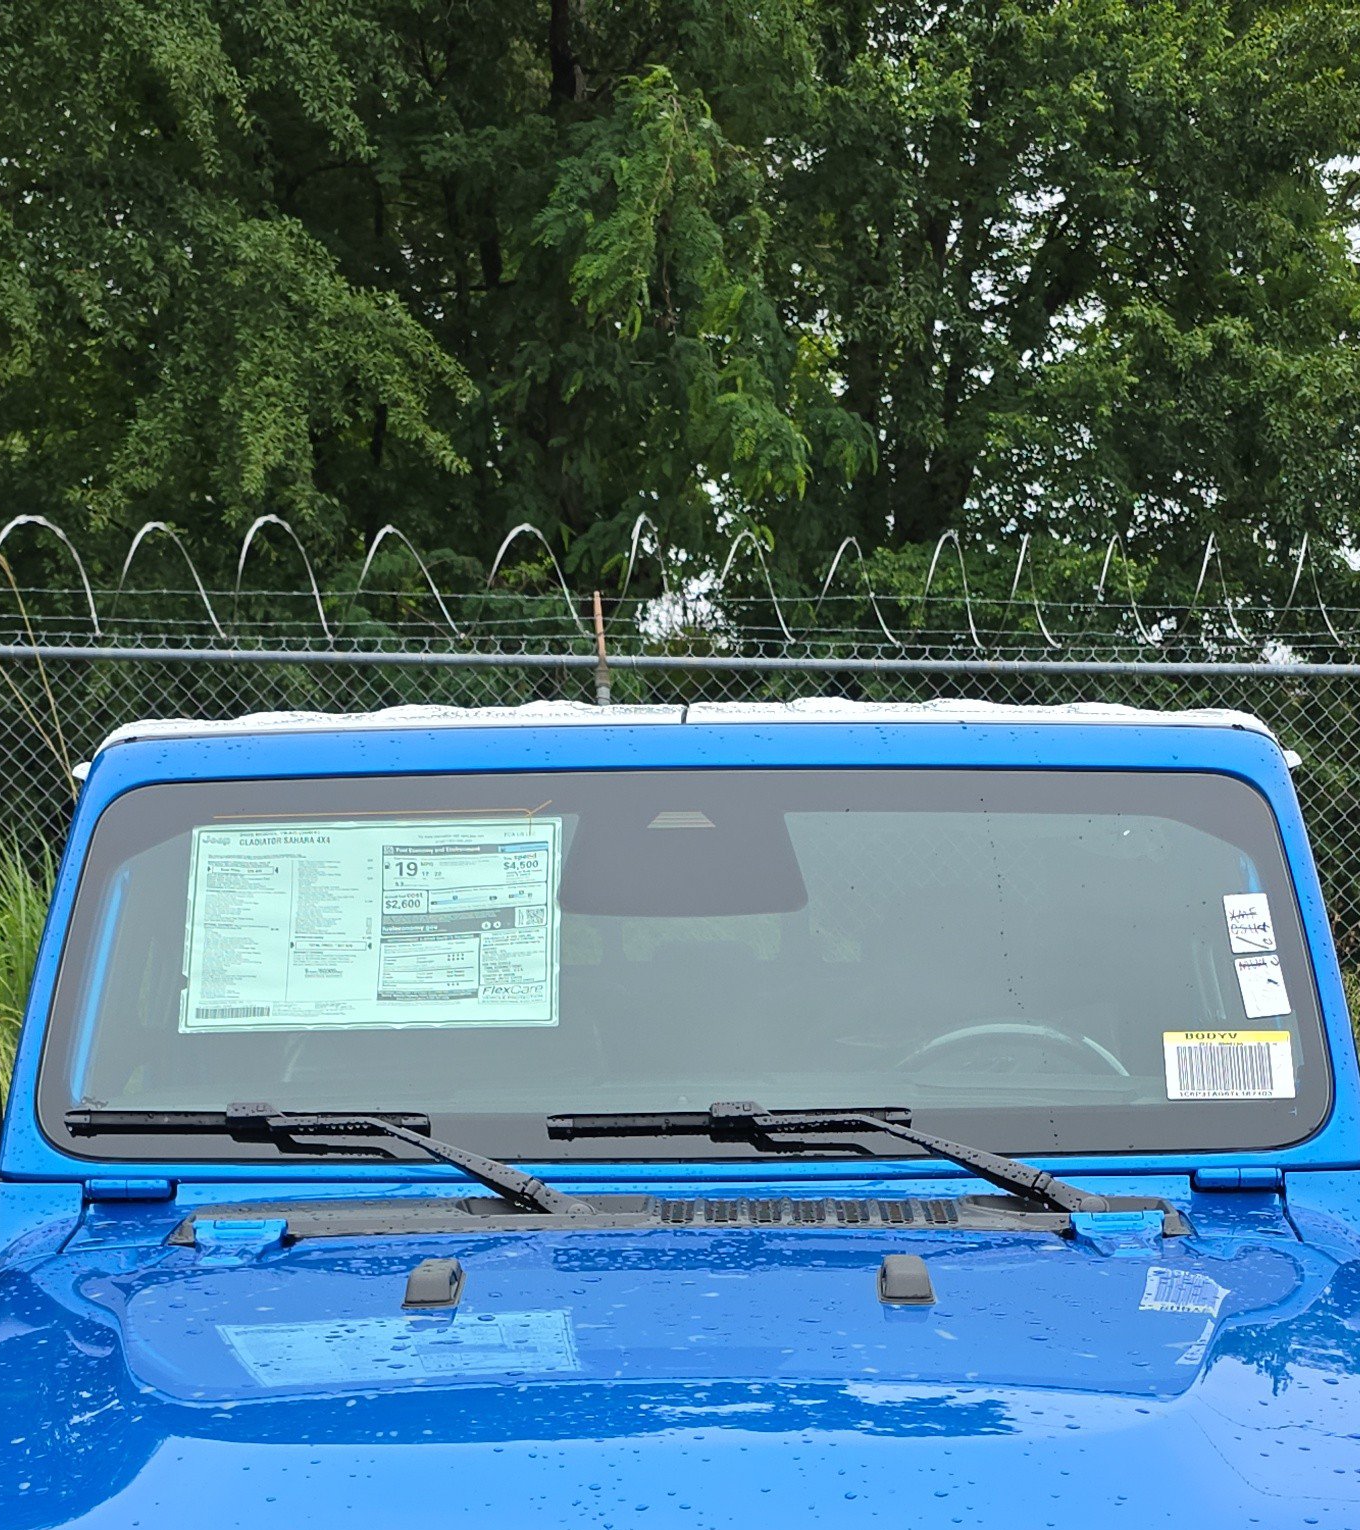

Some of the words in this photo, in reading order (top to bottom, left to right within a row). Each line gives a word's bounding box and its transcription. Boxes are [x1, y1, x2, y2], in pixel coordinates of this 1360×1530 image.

[239, 837, 282, 847] GLADIATOR
[283, 836, 315, 845] SAHARA
[316, 836, 331, 844] 4X4
[395, 861, 418, 877] 19
[503, 860, 539, 871] $4,500
[385, 899, 421, 910] $2,600
[482, 985, 544, 996] FlexCare
